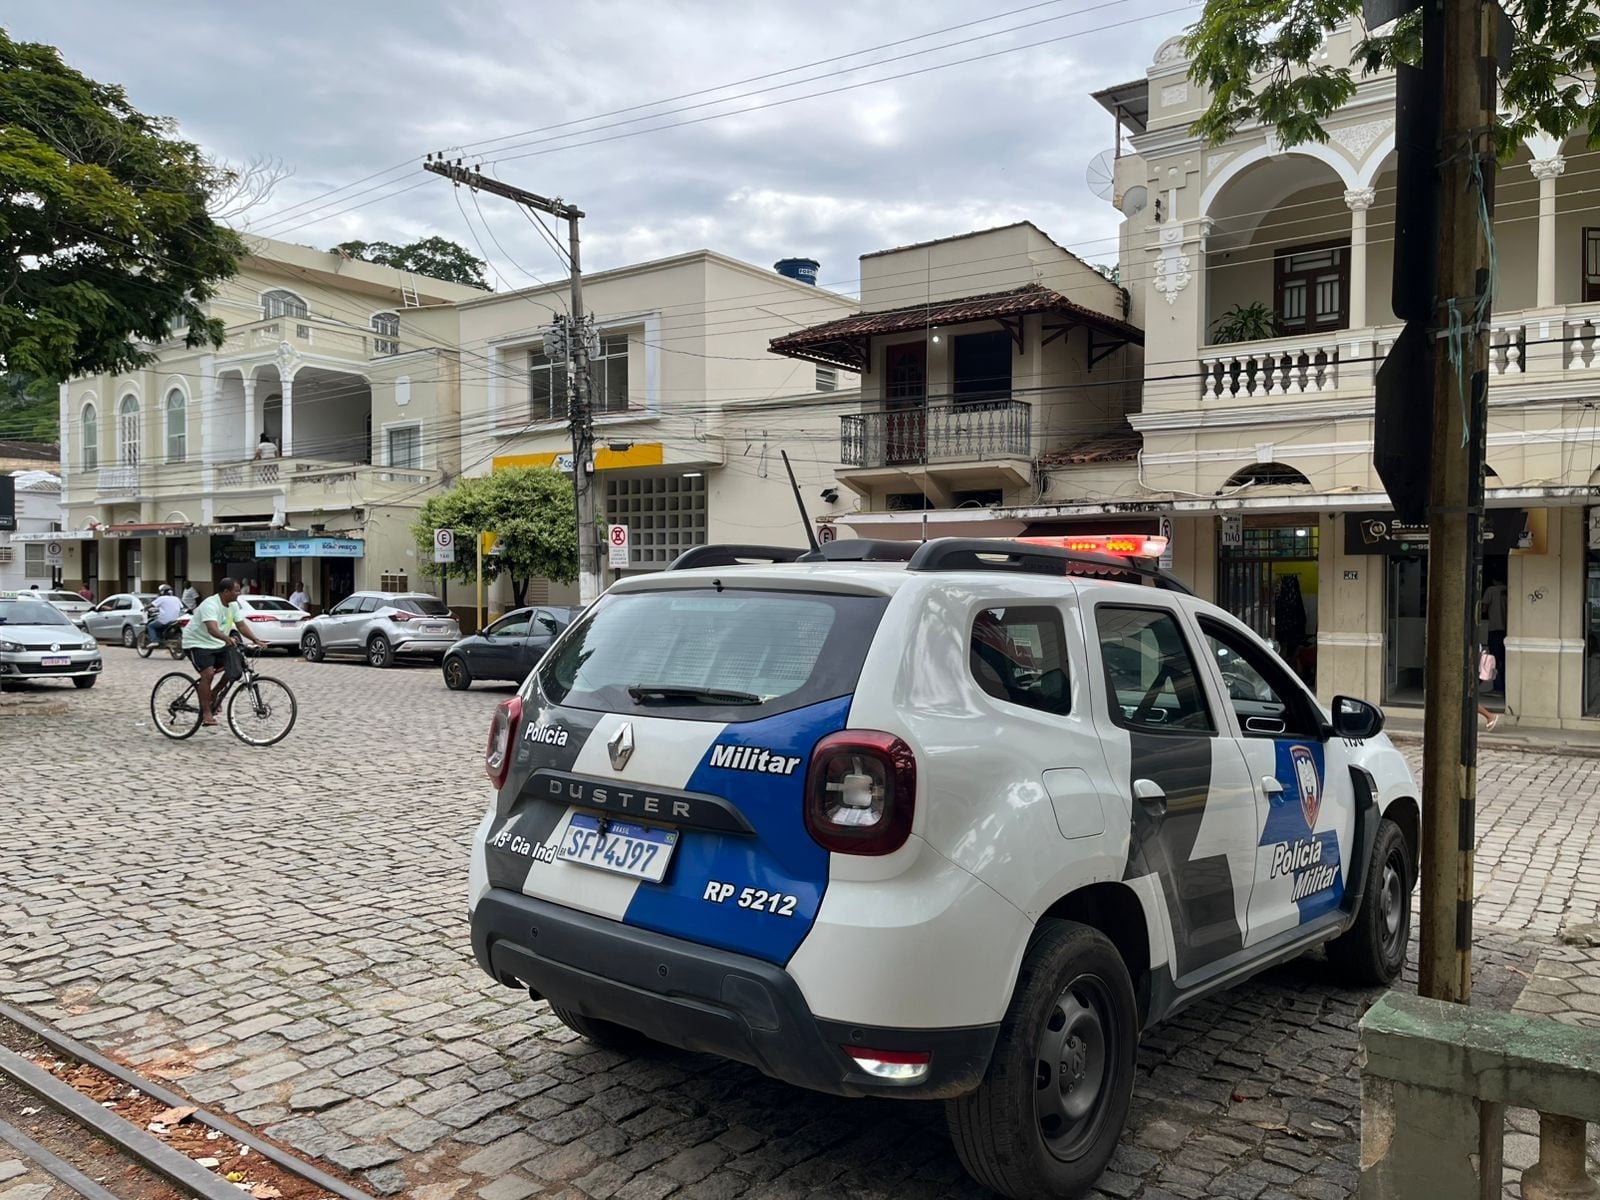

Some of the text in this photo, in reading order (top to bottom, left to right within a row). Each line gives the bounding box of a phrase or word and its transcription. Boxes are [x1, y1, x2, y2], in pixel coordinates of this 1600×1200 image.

[441, 533, 448, 543] E
[524, 721, 569, 747] Polícia
[709, 744, 801, 775] Militar
[549, 779, 691, 818] DUSTER
[510, 835, 530, 856] Cia
[533, 841, 557, 863] Ind
[567, 829, 659, 873] SFP4J97
[1270, 835, 1323, 879] Polícia
[703, 880, 798, 916] RP 5212
[1291, 864, 1340, 903] Militar
